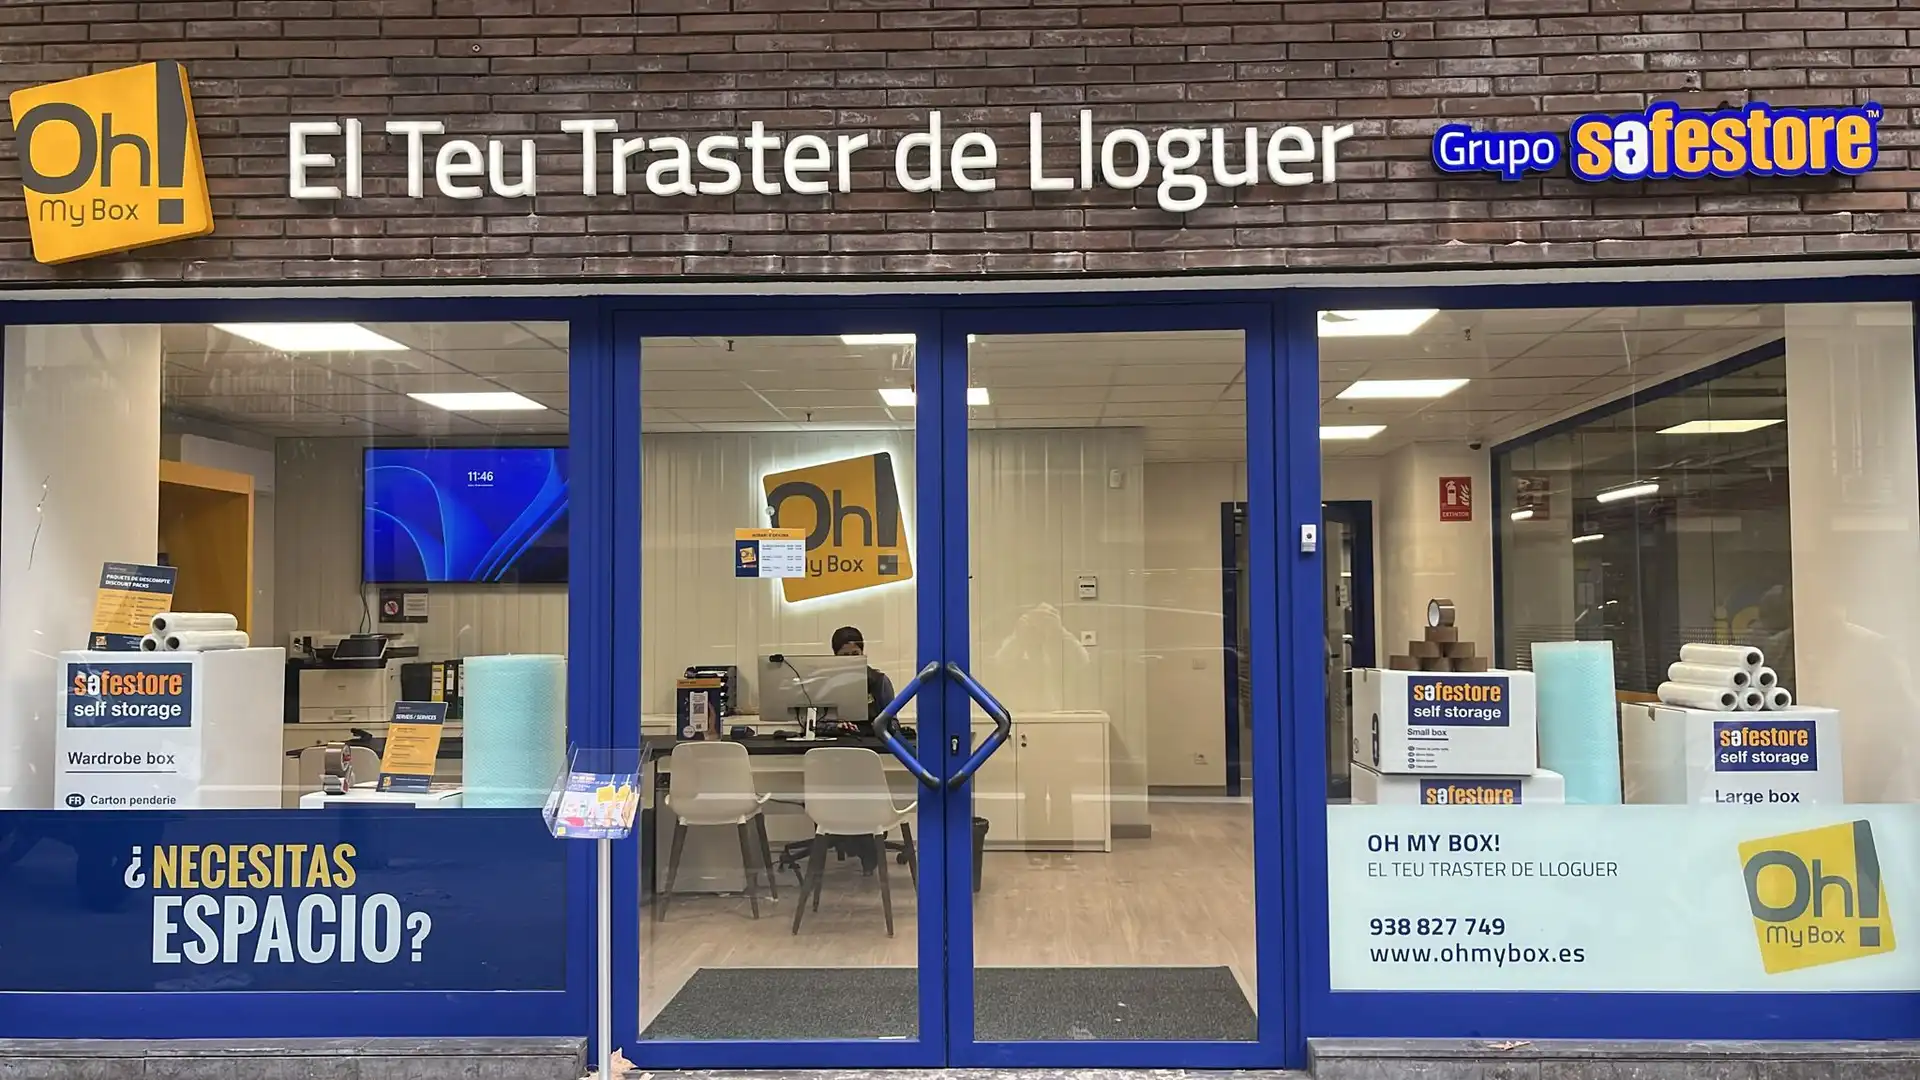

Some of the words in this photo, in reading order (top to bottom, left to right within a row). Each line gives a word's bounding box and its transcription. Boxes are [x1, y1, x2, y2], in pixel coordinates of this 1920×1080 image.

[15, 59, 188, 224] Oh!
[1440, 131, 1554, 166] Grupo
[1577, 109, 1872, 175] safestore
[289, 118, 363, 199] El
[386, 120, 536, 198] Teu
[561, 119, 869, 197] Traster
[894, 111, 998, 193] de
[1029, 109, 1354, 212] Lloguer
[40, 199, 84, 227] My
[92, 199, 139, 220] Box
[468, 471, 494, 481] 11:46
[828, 555, 864, 572] Box
[74, 670, 183, 696] safestore
[1413, 682, 1502, 702] safestore
[74, 701, 107, 717] self
[111, 701, 182, 720] storage
[1414, 705, 1441, 718] self
[1444, 706, 1502, 721] storage
[1407, 728, 1430, 736] Small
[1432, 728, 1447, 736] box
[1720, 727, 1808, 747] safestore
[67, 751, 142, 765] Wardrobe
[146, 751, 175, 765] box
[1720, 751, 1748, 763] self
[1751, 751, 1809, 766] storage
[69, 796, 82, 805] FR
[90, 795, 127, 805] Carton
[129, 795, 177, 807] penderie
[1426, 785, 1514, 804] safestore
[1715, 789, 1764, 804] Large
[1768, 789, 1800, 803] box
[1367, 834, 1399, 852] OH
[1407, 834, 1441, 852] MY
[1448, 834, 1501, 852] BOX!
[1368, 862, 1388, 877] EL
[1391, 862, 1425, 877] TEU
[1429, 862, 1506, 877] TRASTER
[1512, 862, 1534, 877] DE
[1539, 862, 1618, 877] LLOGUER
[1743, 819, 1880, 947] Oh!
[152, 893, 432, 964] ESPACIO?
[1370, 918, 1411, 936] 938
[1416, 918, 1457, 936] 827
[1464, 918, 1505, 936] 749
[1766, 926, 1803, 947] My
[1808, 926, 1845, 944] Box
[1370, 943, 1586, 968] www.ohmybox.es
